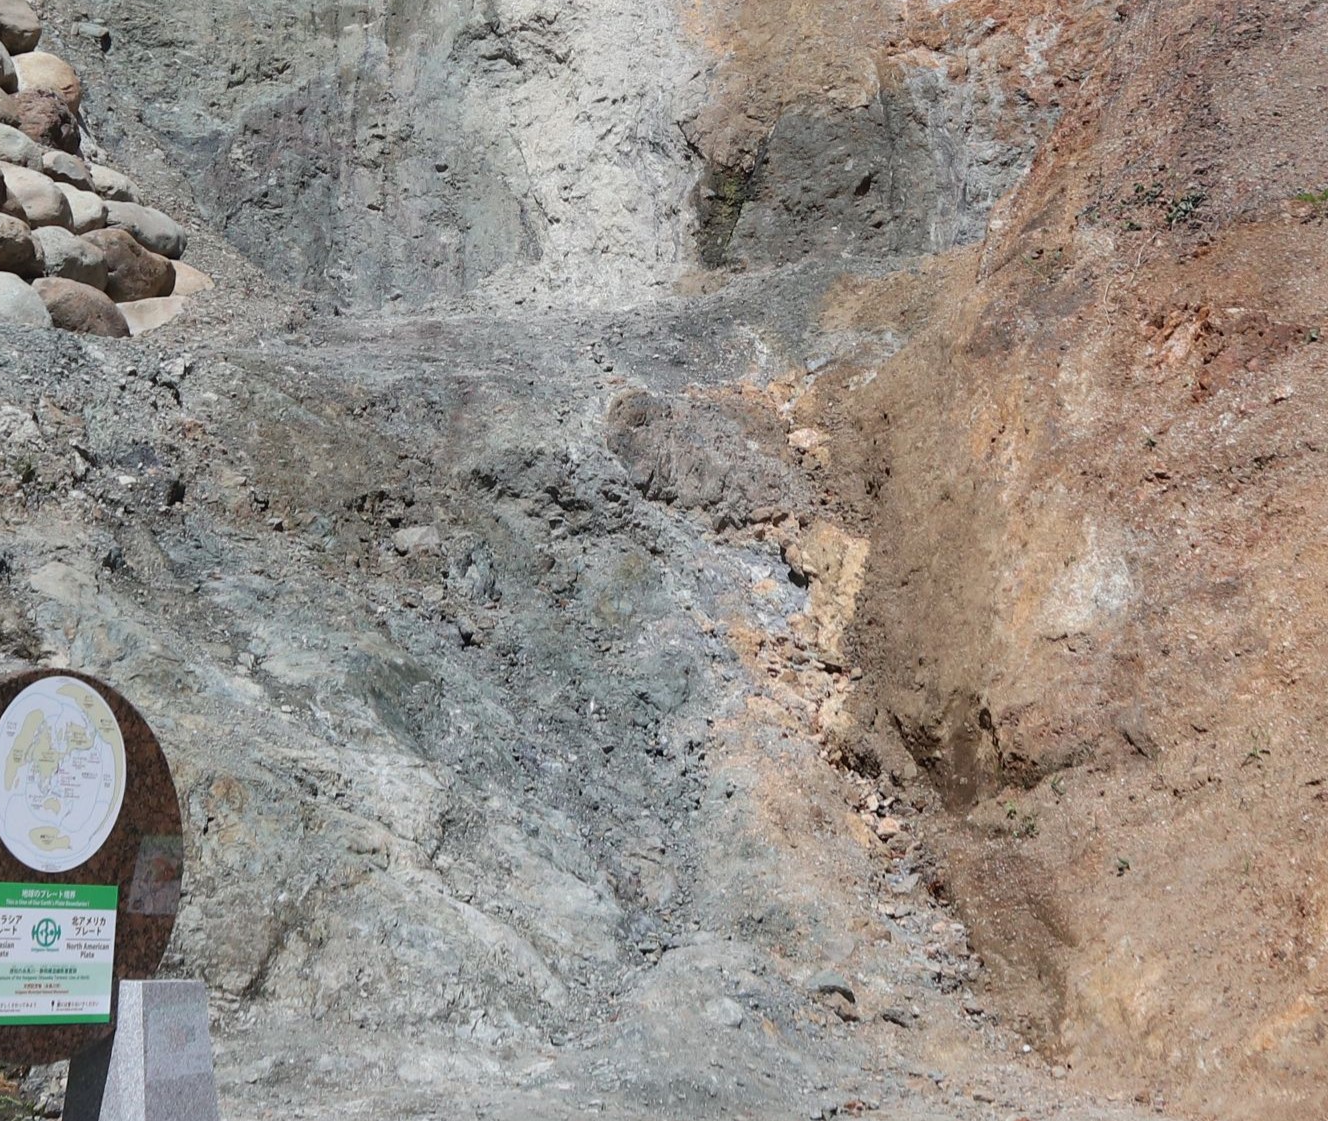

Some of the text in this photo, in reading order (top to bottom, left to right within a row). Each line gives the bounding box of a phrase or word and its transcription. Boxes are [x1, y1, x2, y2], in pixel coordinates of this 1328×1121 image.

[72, 916, 106, 926] 北アメリカ
[75, 926, 101, 936] プレート
[66, 942, 83, 950] North
[83, 942, 110, 950] American
[80, 950, 95, 959] Plate
